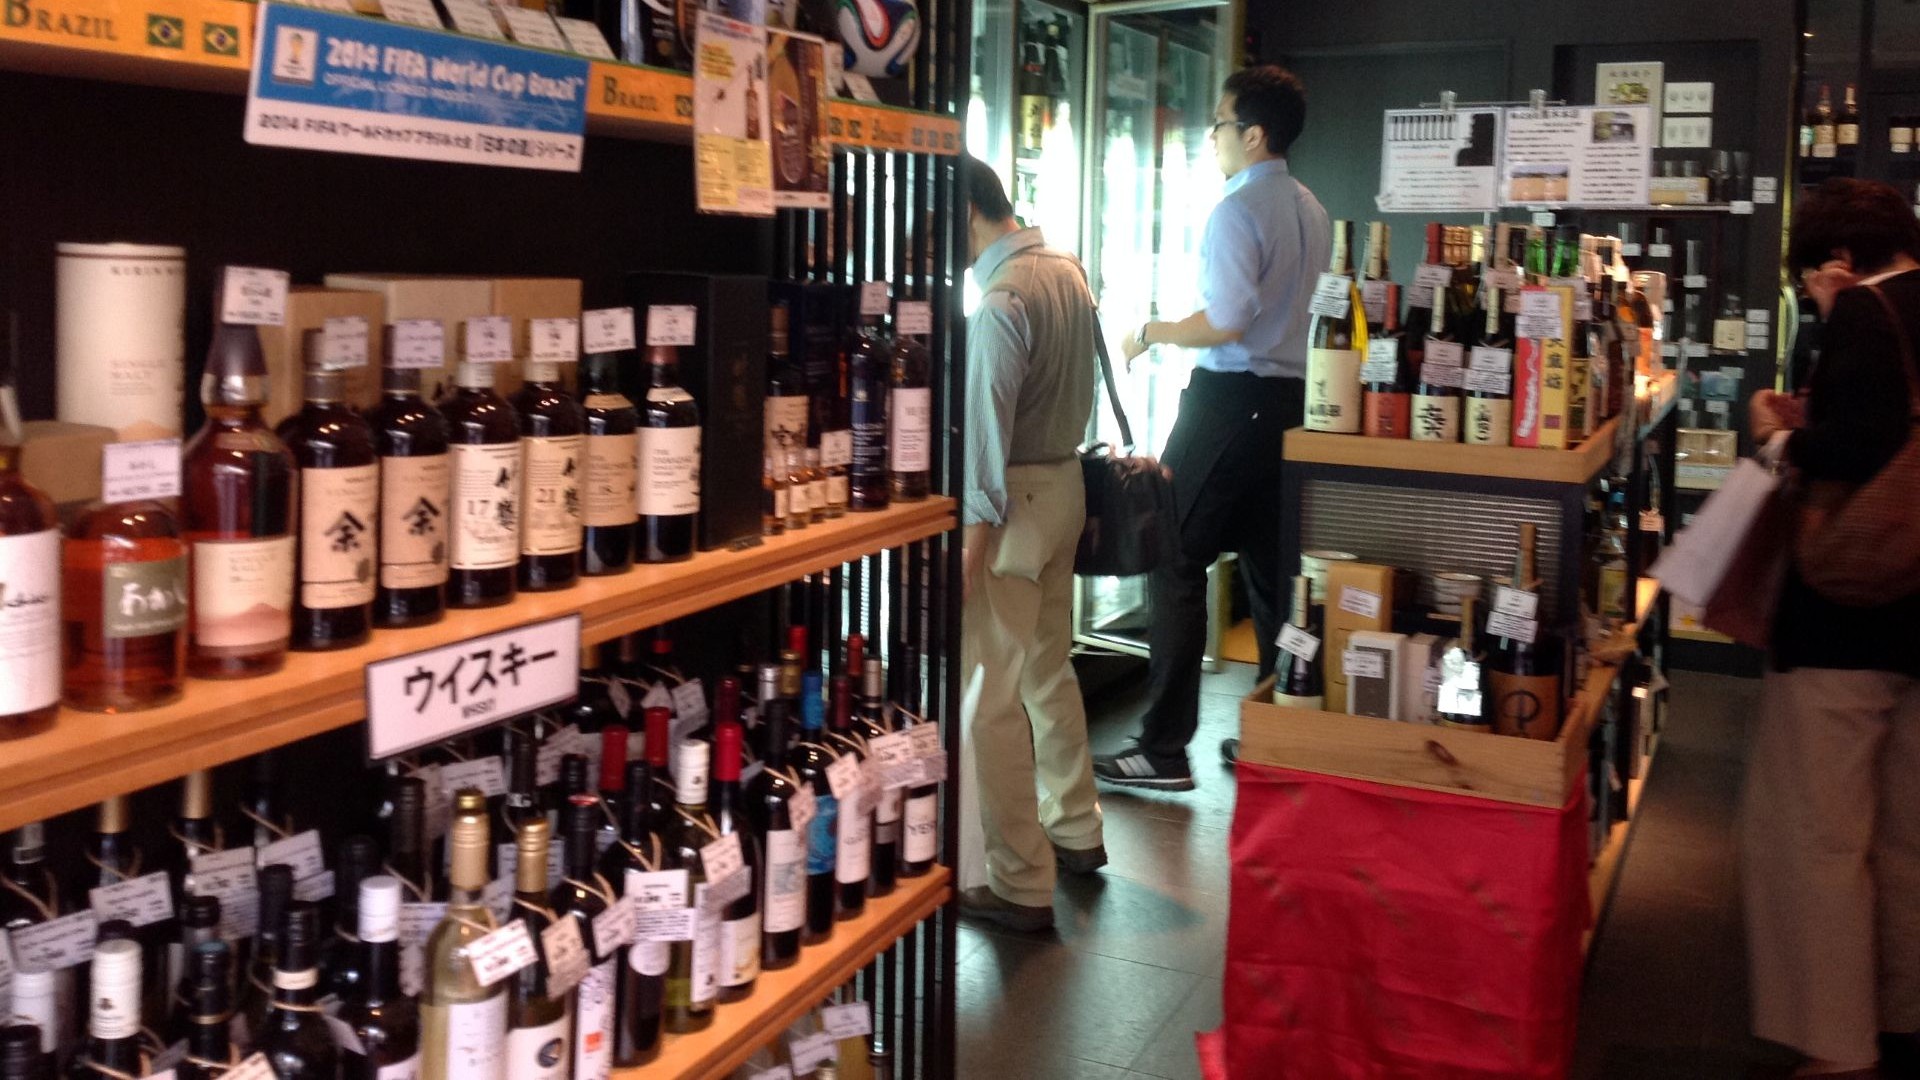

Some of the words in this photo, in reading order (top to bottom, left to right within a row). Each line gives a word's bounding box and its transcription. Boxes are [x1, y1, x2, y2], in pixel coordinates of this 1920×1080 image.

[326, 37, 379, 72] 2014
[383, 46, 428, 79] FIFA
[431, 56, 490, 88] World
[491, 65, 526, 99] Cup
[259, 113, 300, 130] 2014
[537, 488, 556, 503] 21
[467, 499, 489, 515] 17
[404, 642, 557, 714] ウイスキー
